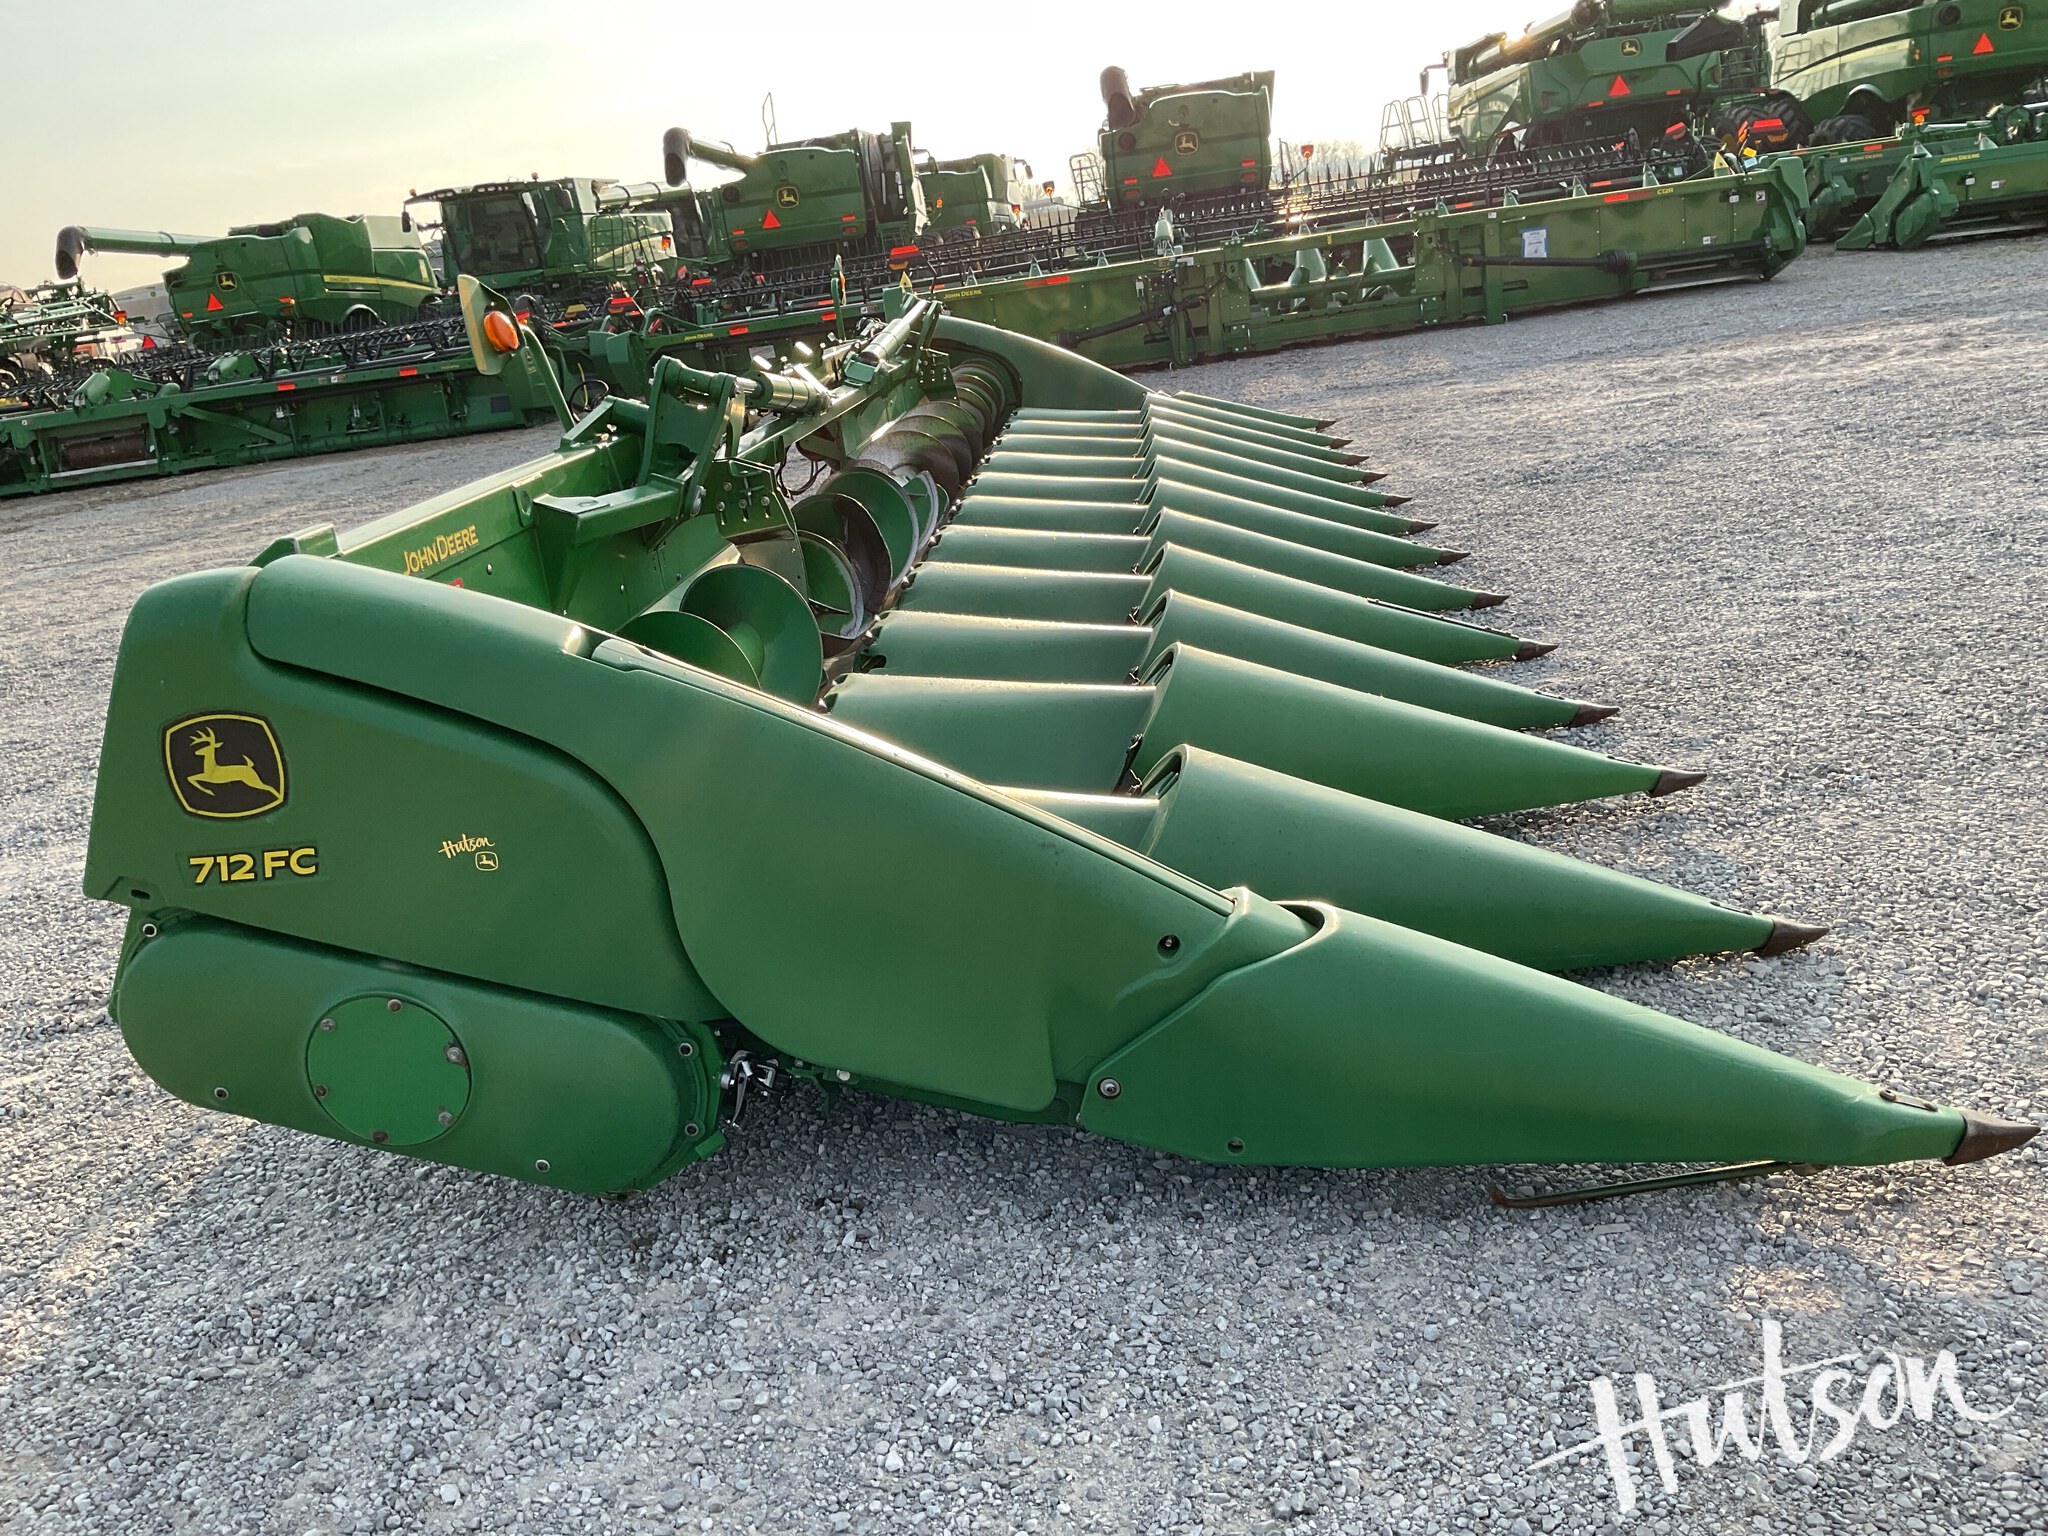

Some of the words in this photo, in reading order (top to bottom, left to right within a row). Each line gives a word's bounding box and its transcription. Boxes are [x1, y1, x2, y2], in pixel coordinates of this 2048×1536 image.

[403, 543, 438, 576] JOHN
[435, 524, 479, 560] DEERE
[438, 833, 496, 859] Hutson
[188, 853, 255, 884] 712
[263, 847, 317, 878] FC
